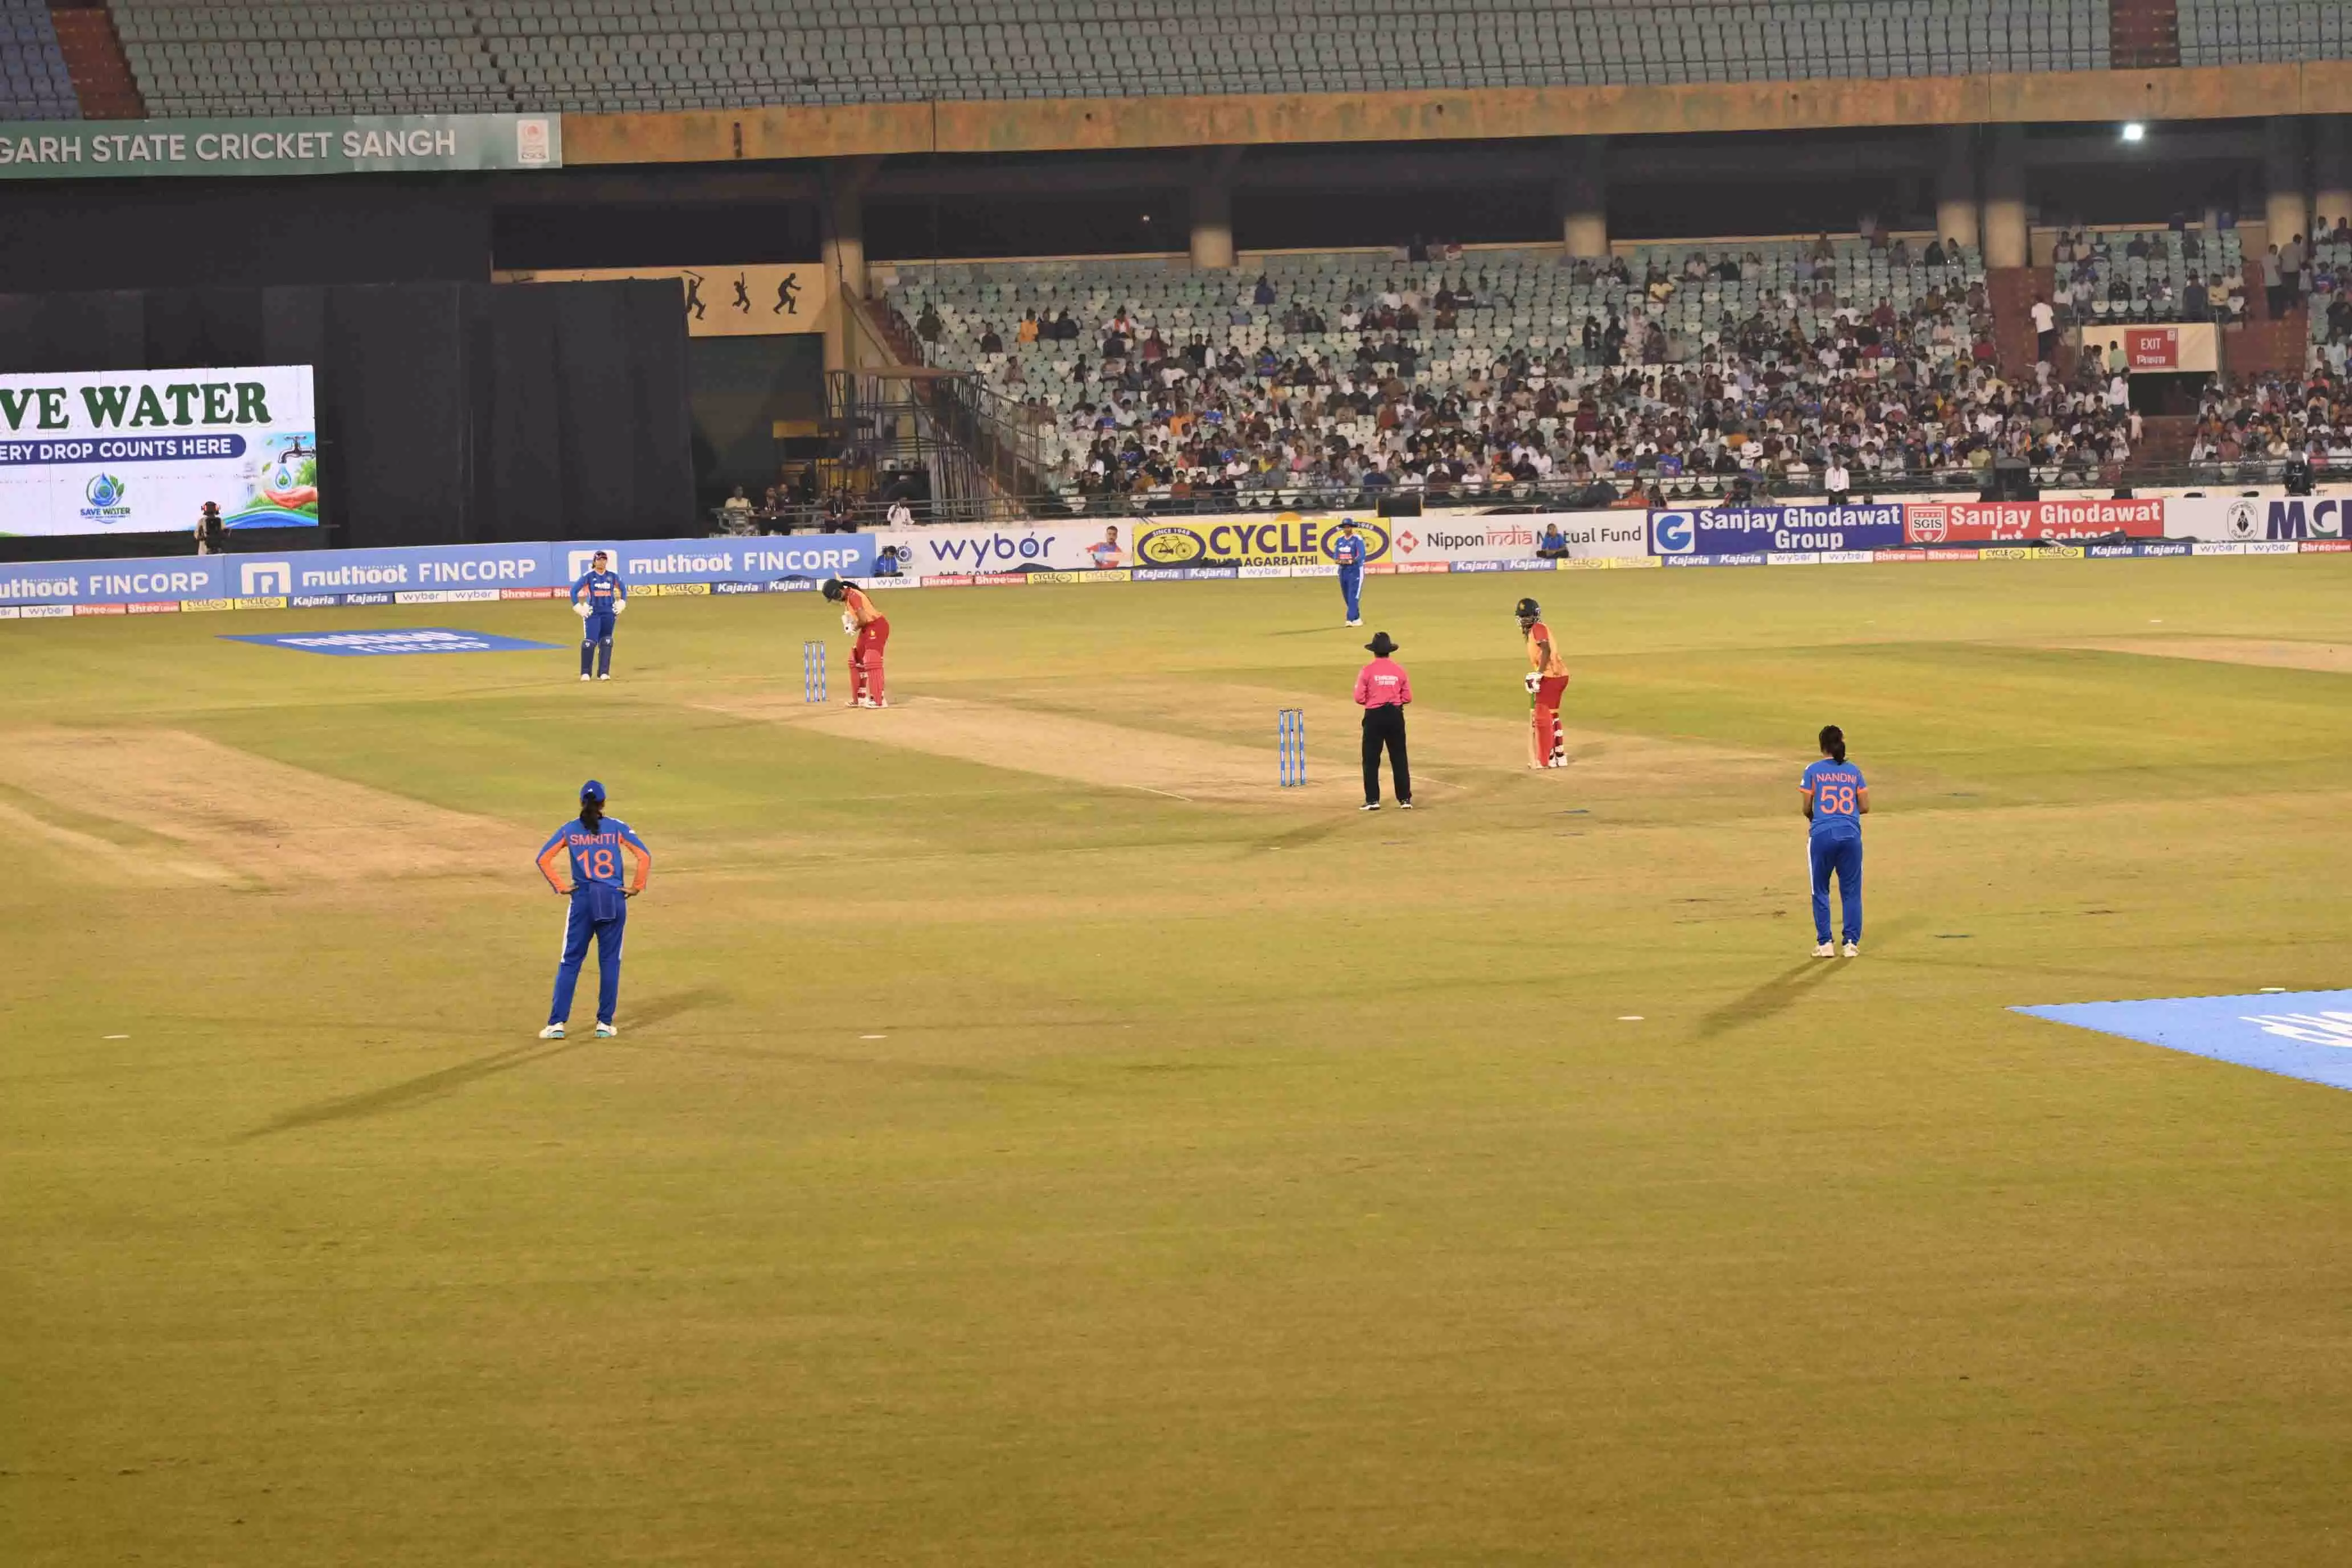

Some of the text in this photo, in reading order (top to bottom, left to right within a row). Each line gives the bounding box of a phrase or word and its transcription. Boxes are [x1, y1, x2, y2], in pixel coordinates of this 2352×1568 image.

[92, 134, 186, 162] STATE
[195, 132, 333, 161] CRICKET
[342, 130, 455, 158] SANGH
[2141, 337, 2161, 350] EXIT
[0, 382, 272, 431] VE WATER
[0, 438, 232, 460] ERY DROP COUNTS HERE
[103, 506, 131, 515] WATER
[1951, 501, 2161, 529] Sanjay Ghodawat
[1700, 505, 1900, 533] Sanjay Ghodawat
[1914, 519, 1942, 528] SGIS
[1152, 528, 1191, 537] SINCE 1948
[1427, 533, 1484, 550] Nippon
[1485, 524, 1533, 546] india
[1602, 526, 1642, 542] Fund
[1210, 523, 1318, 555] CYCLE
[1775, 529, 1844, 550] Group
[2092, 546, 2133, 557] Kajaria
[2145, 545, 2185, 556] Kajaria
[2301, 543, 2331, 552] Shree
[629, 552, 733, 574] muthoot
[744, 549, 860, 571] FINCORP
[1244, 555, 1318, 567] AGARBATHI
[1668, 556, 1709, 566] Kajaria
[1720, 554, 1761, 565] Kajaria
[1875, 551, 1906, 561] Shree
[1456, 561, 1497, 571] Kajaria
[1510, 559, 1550, 570] Kajaria
[303, 559, 536, 587] muthoot FINCORP
[1139, 570, 1178, 580] Kajaria
[1190, 568, 1231, 579] Kajaria
[90, 572, 209, 596] FINCORP
[717, 582, 759, 593] Kajaria
[770, 581, 810, 592] Kajaria
[346, 593, 388, 605] Kajaria
[501, 590, 532, 598] Shree
[293, 595, 334, 607] Kajaria
[1820, 785, 1855, 815] 58
[570, 834, 616, 846] SMRITI
[577, 849, 614, 879] 18
